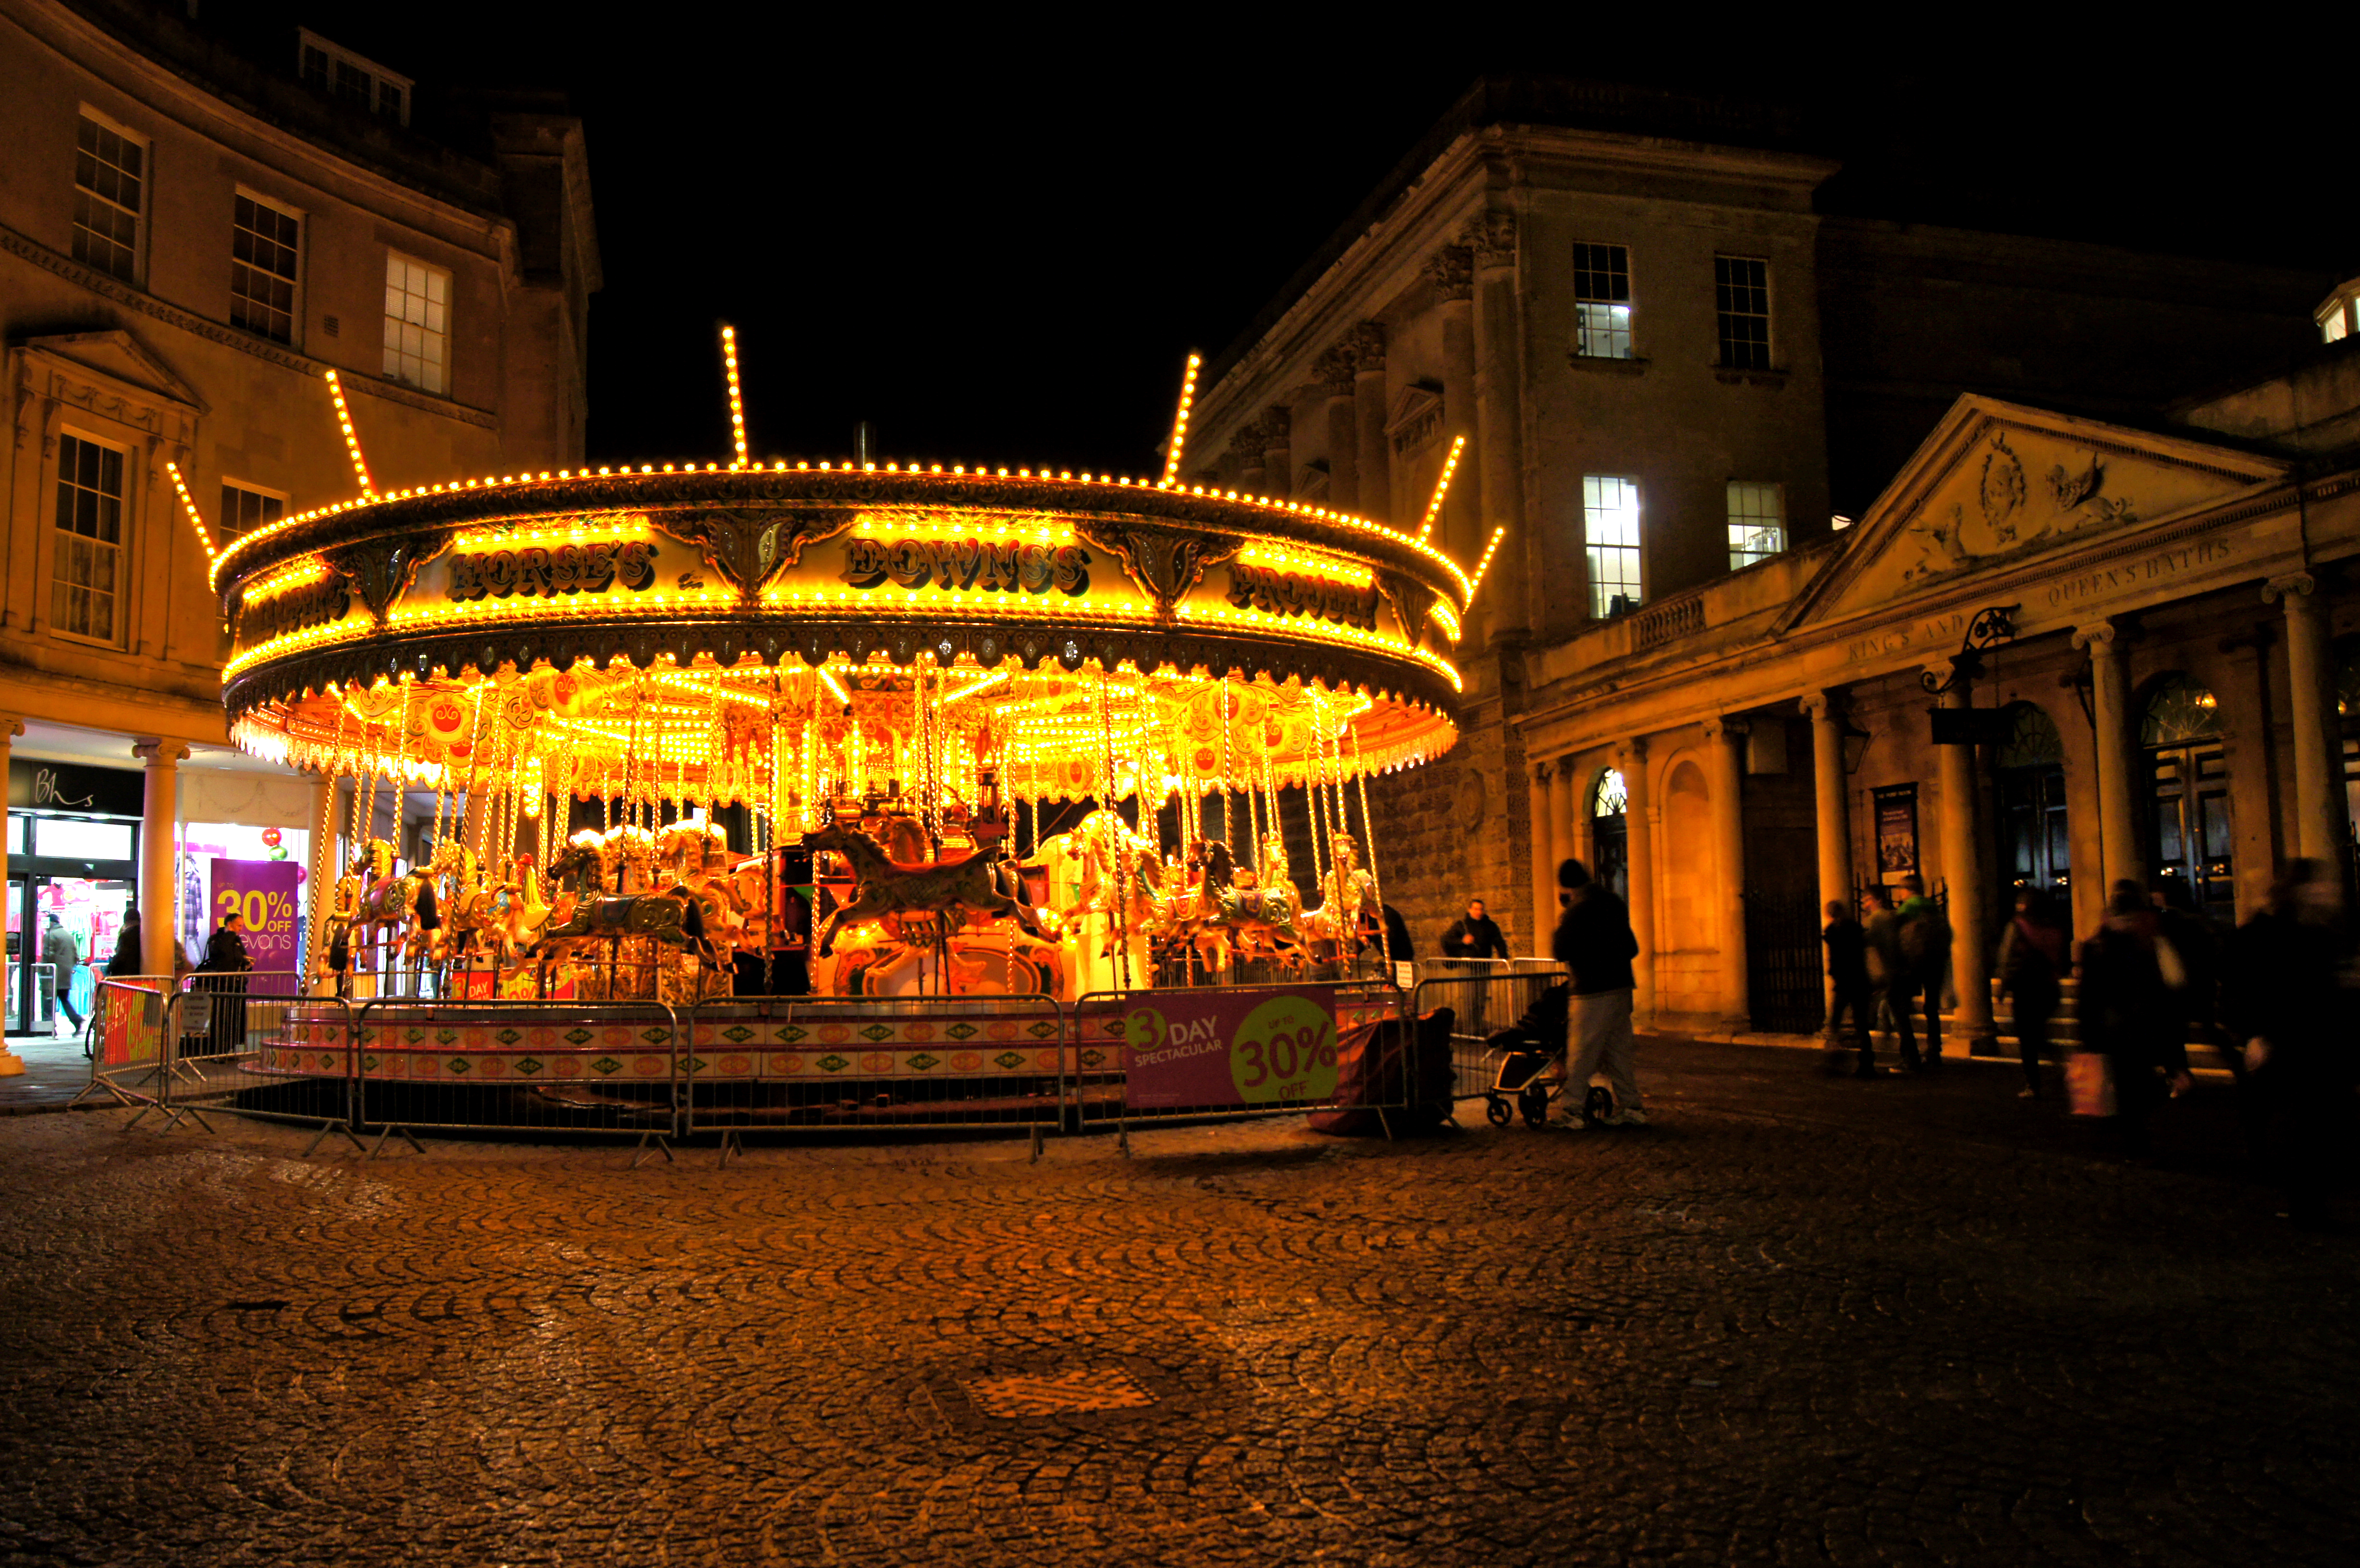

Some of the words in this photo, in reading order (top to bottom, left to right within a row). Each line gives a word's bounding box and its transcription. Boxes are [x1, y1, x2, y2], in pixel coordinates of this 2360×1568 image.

[445, 539, 659, 601] HORSE'S
[838, 536, 1092, 598] DOWNS'S
[1226, 562, 1379, 633] PROUDLY
[36, 769, 94, 807] Bhs
[217, 889, 293, 932] 30%
[268, 920, 292, 932] OFF
[239, 934, 291, 949] evans
[469, 981, 488, 997] DAY
[1134, 1010, 1159, 1049] 3
[1169, 1015, 1218, 1045] DAY
[1268, 1018, 1280, 1029] UP
[1282, 1015, 1295, 1024] TO
[1134, 1039, 1222, 1067] SPECTACULAR
[1239, 1021, 1337, 1087] 30%
[1279, 1080, 1309, 1100] OFF
